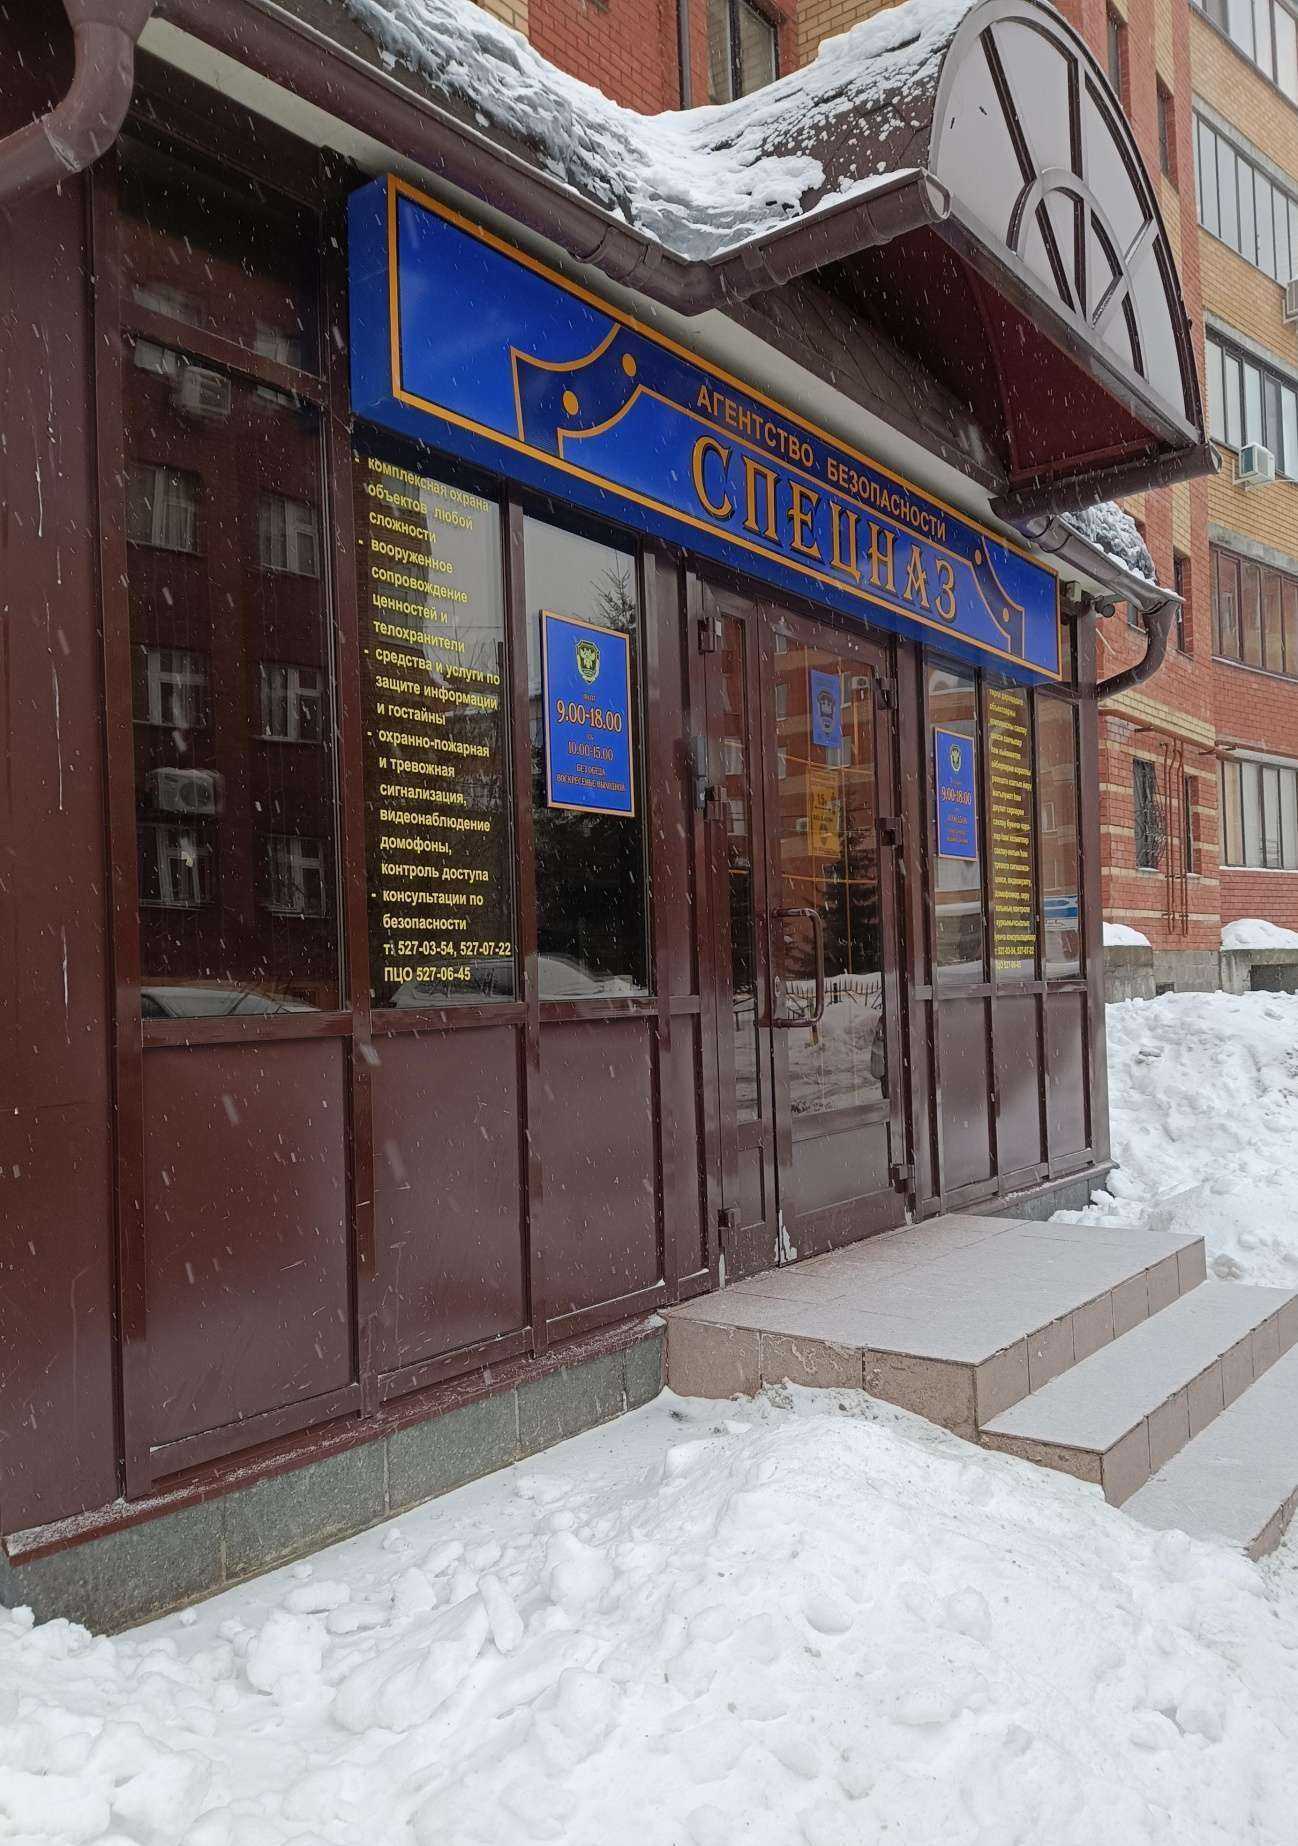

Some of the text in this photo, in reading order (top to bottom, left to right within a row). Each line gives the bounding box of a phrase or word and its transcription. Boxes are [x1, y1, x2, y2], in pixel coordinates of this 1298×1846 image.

[697, 385, 946, 542] АГЕНТСТВО БЕЗОПАСНОСТИ
[368, 458, 489, 512] комплексная охрана
[368, 484, 473, 530] объектов любой
[369, 512, 436, 543] сложности
[691, 436, 956, 621] СПЕЦНАЗ
[372, 539, 453, 574] вооруженное
[372, 566, 468, 603] сопровождение
[372, 594, 448, 624] ценностей и
[373, 621, 465, 653] телохранители
[375, 649, 500, 685] средства и услуги по
[375, 675, 498, 710] защите информации
[377, 703, 446, 726] и гостайны
[557, 700, 622, 733] 9.00-18.00
[379, 730, 490, 757] охранно-пожарная
[379, 757, 455, 778] и тревожная
[380, 783, 467, 806] сигнализация,
[380, 811, 491, 832] видеонаблюдение
[380, 836, 452, 855] домофоны,
[381, 863, 489, 882] контроль доступа
[383, 889, 484, 906] консультации по
[383, 914, 467, 930] безопасности
[398, 940, 457, 958] 527-03-54,
[460, 941, 512, 956] 527-07-22
[384, 966, 471, 984] ПЦО 527-06-45
